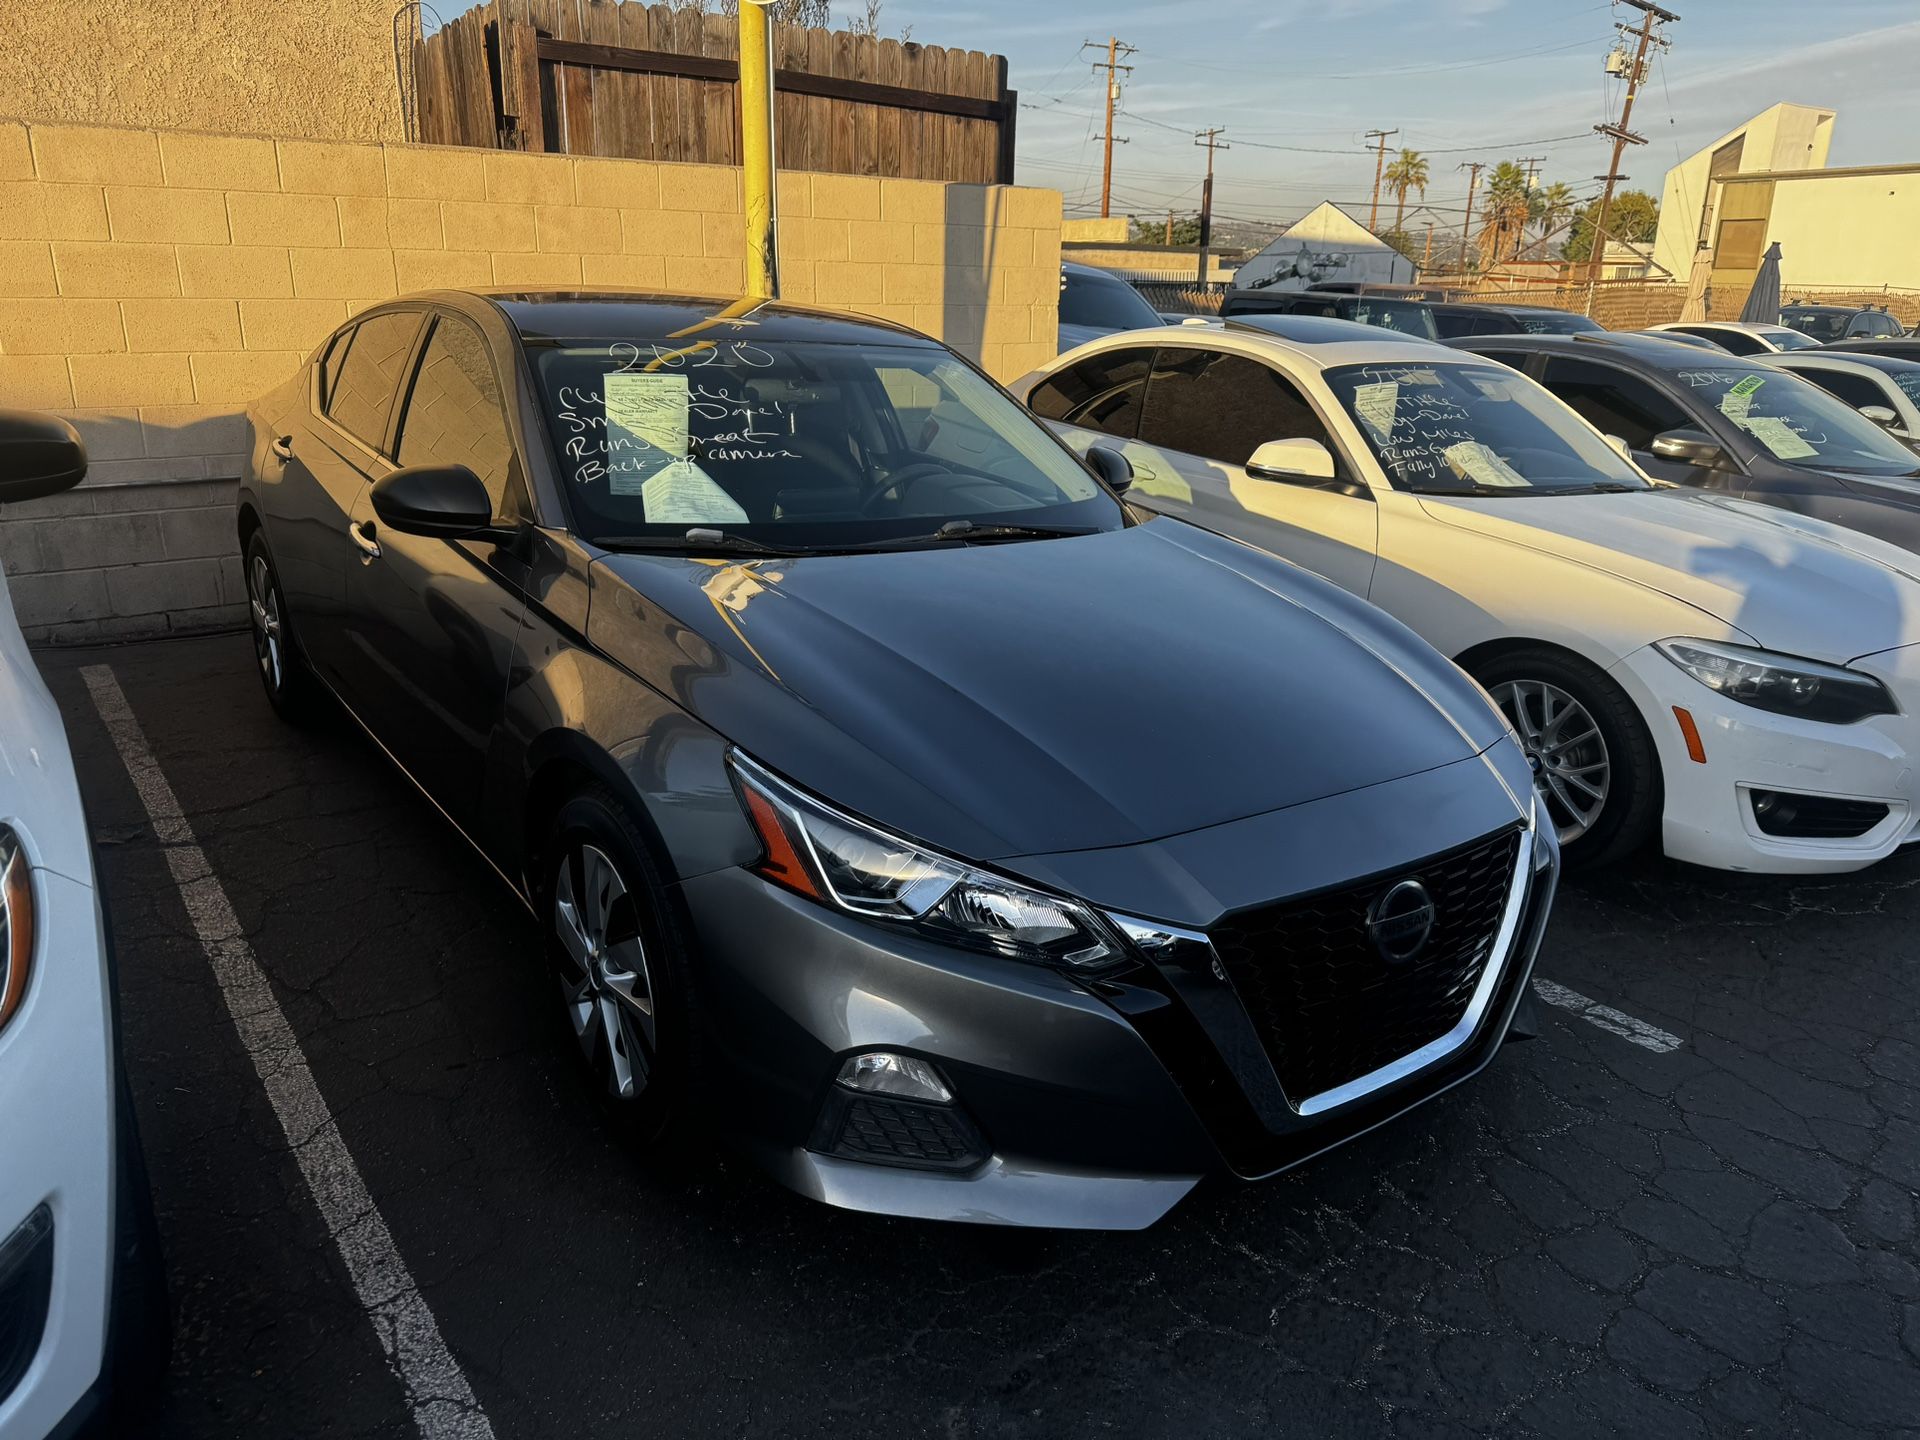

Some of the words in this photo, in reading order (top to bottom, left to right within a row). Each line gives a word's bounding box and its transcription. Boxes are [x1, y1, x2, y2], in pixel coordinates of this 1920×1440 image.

[608, 342, 775, 373] 2020
[1678, 371, 1735, 387] 2016
[566, 434, 650, 462] Runs
